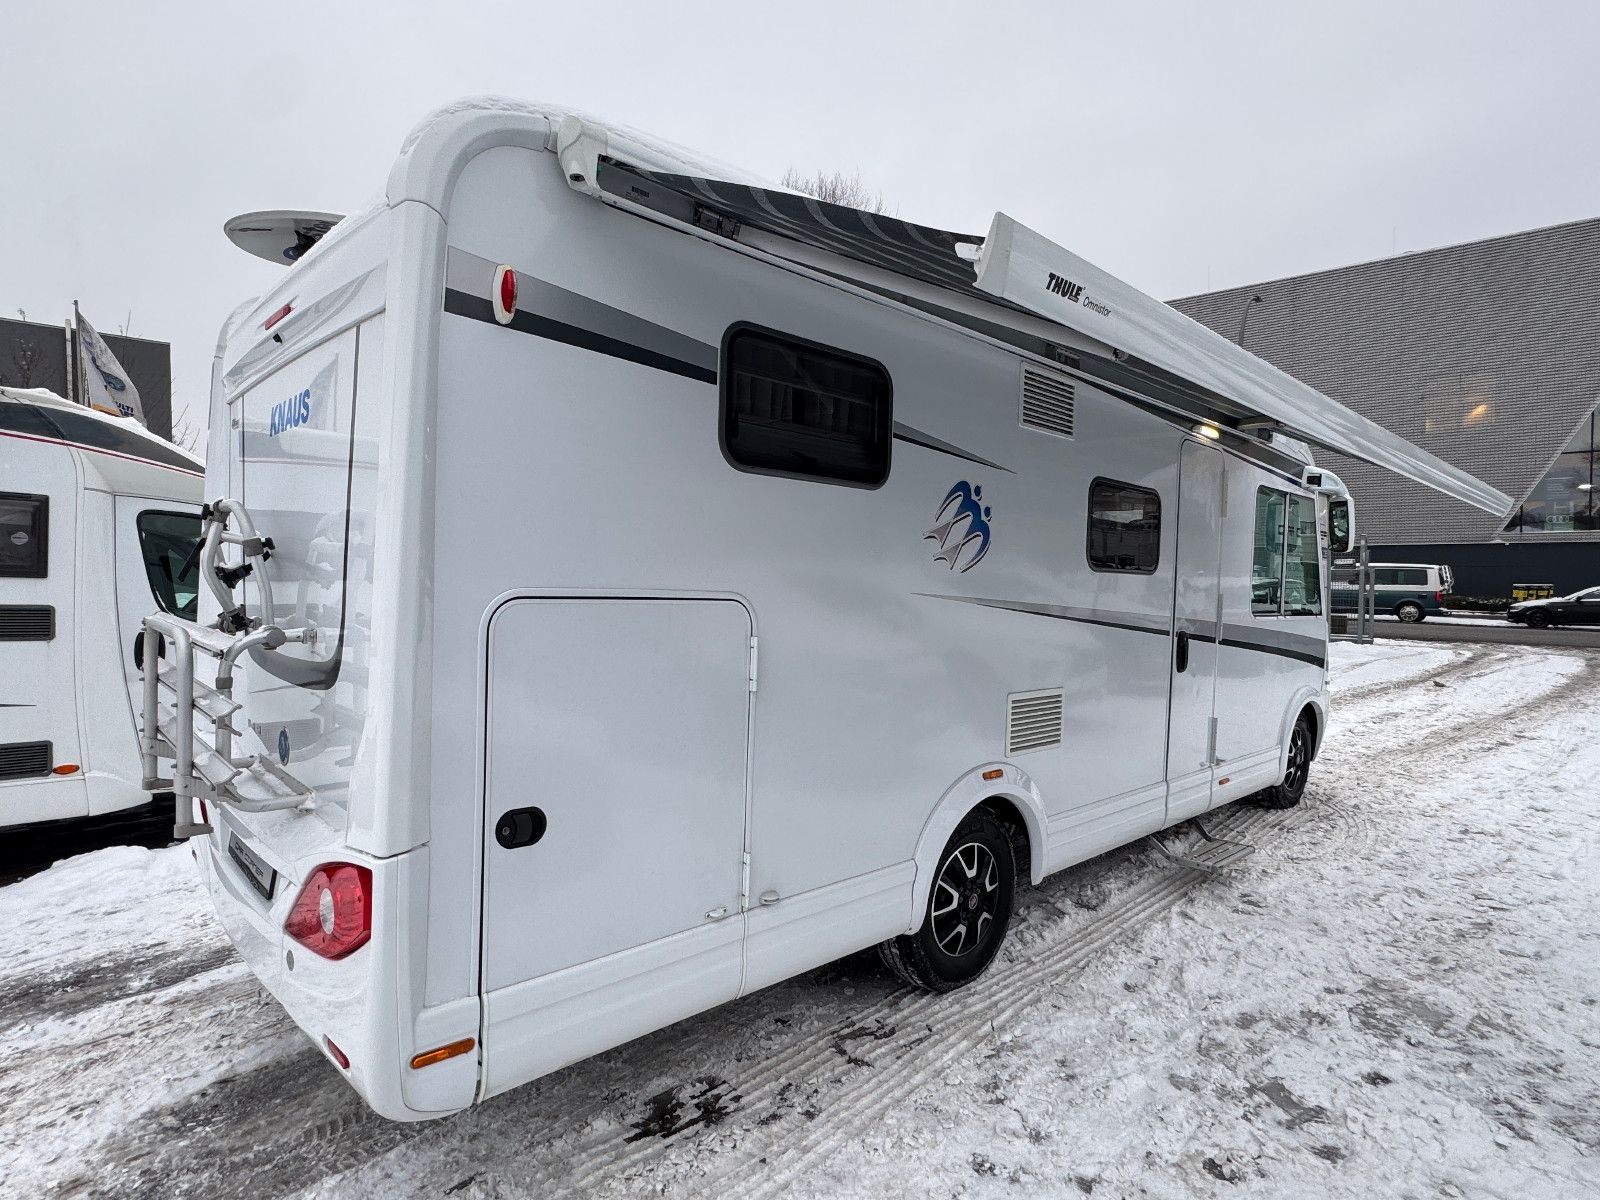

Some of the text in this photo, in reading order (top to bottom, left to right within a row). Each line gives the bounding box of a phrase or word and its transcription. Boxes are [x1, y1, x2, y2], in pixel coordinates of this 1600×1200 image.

[1046, 272, 1111, 317] THULE Omnistor
[269, 388, 311, 437] KNAUS
